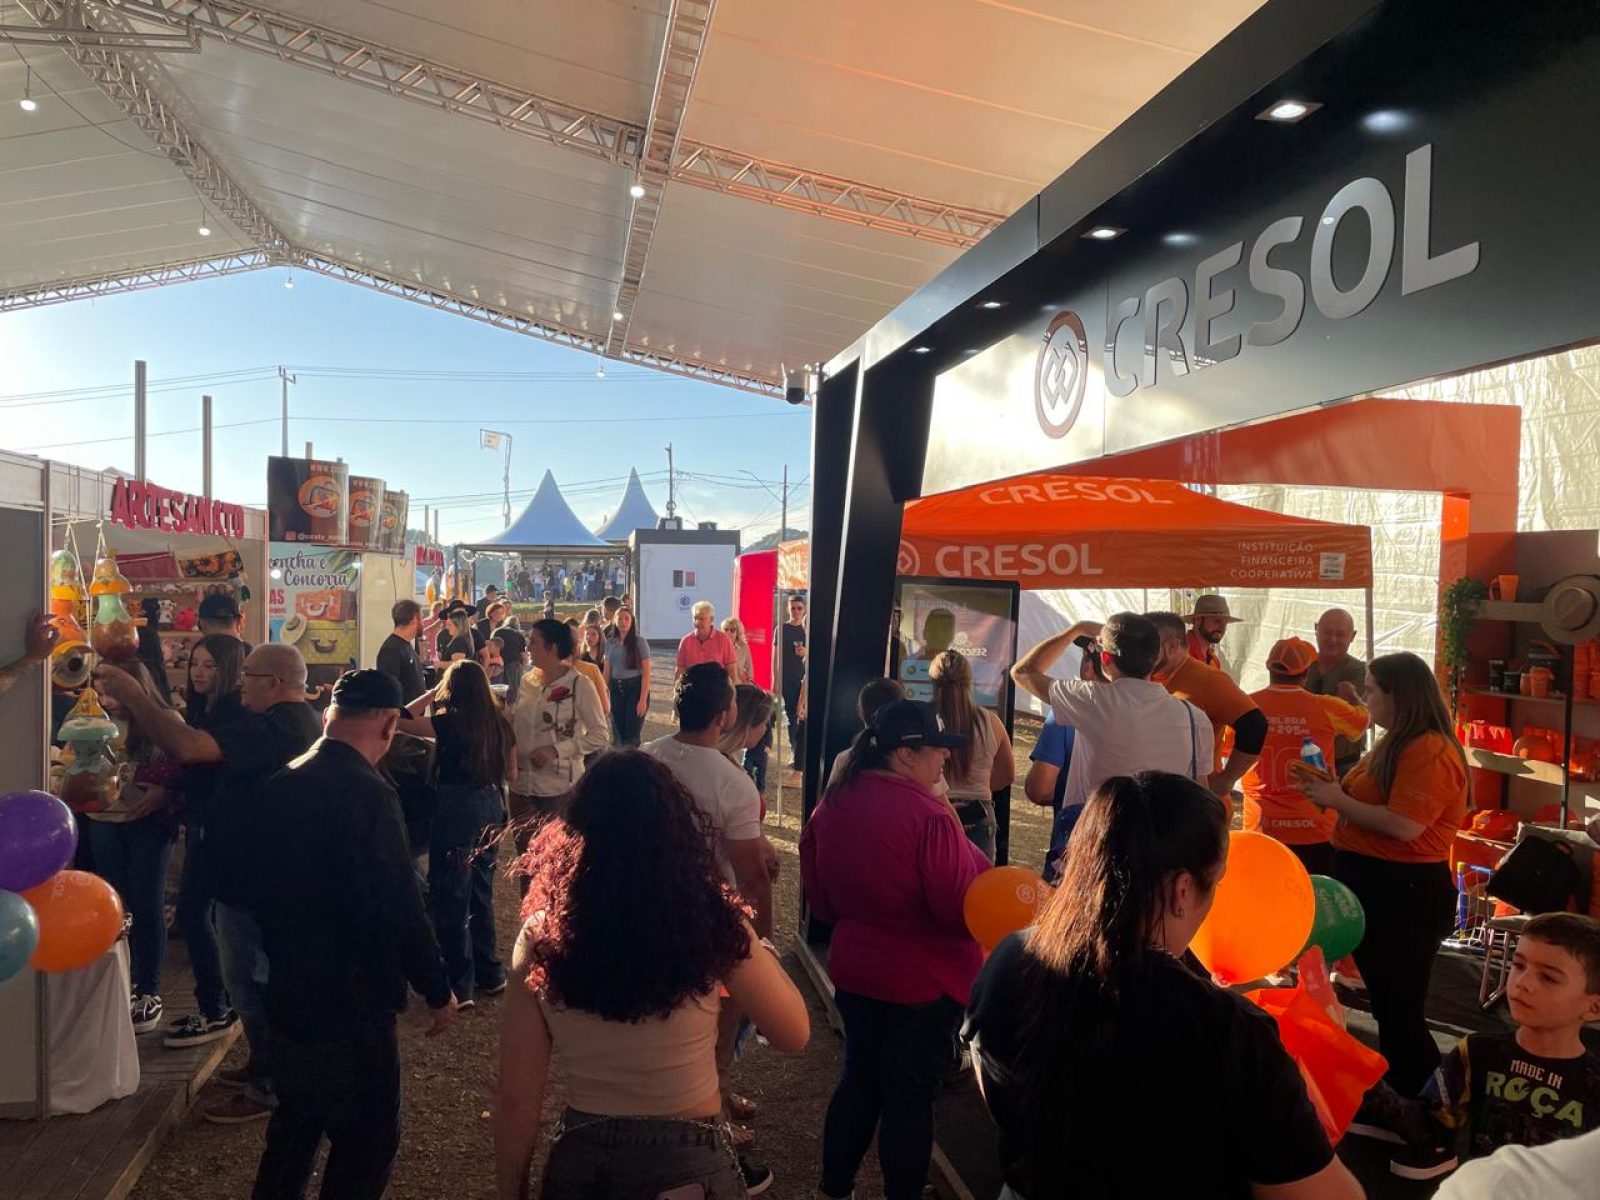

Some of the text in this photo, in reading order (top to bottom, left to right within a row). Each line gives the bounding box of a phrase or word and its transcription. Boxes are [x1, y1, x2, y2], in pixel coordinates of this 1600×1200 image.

[1104, 143, 1480, 397] CRESOL
[979, 481, 1174, 505] CRESOL
[110, 476, 244, 539] ARTESANATO
[935, 543, 1104, 576] CRESOL
[1241, 556, 1314, 566] FINANCEIRA
[284, 569, 347, 588] Concorra
[1230, 569, 1313, 580] COOPERATIVA
[1272, 819, 1317, 828] CRESOL
[1510, 1060, 1563, 1090] MADE IN
[1485, 1071, 1583, 1128] ROÇA
